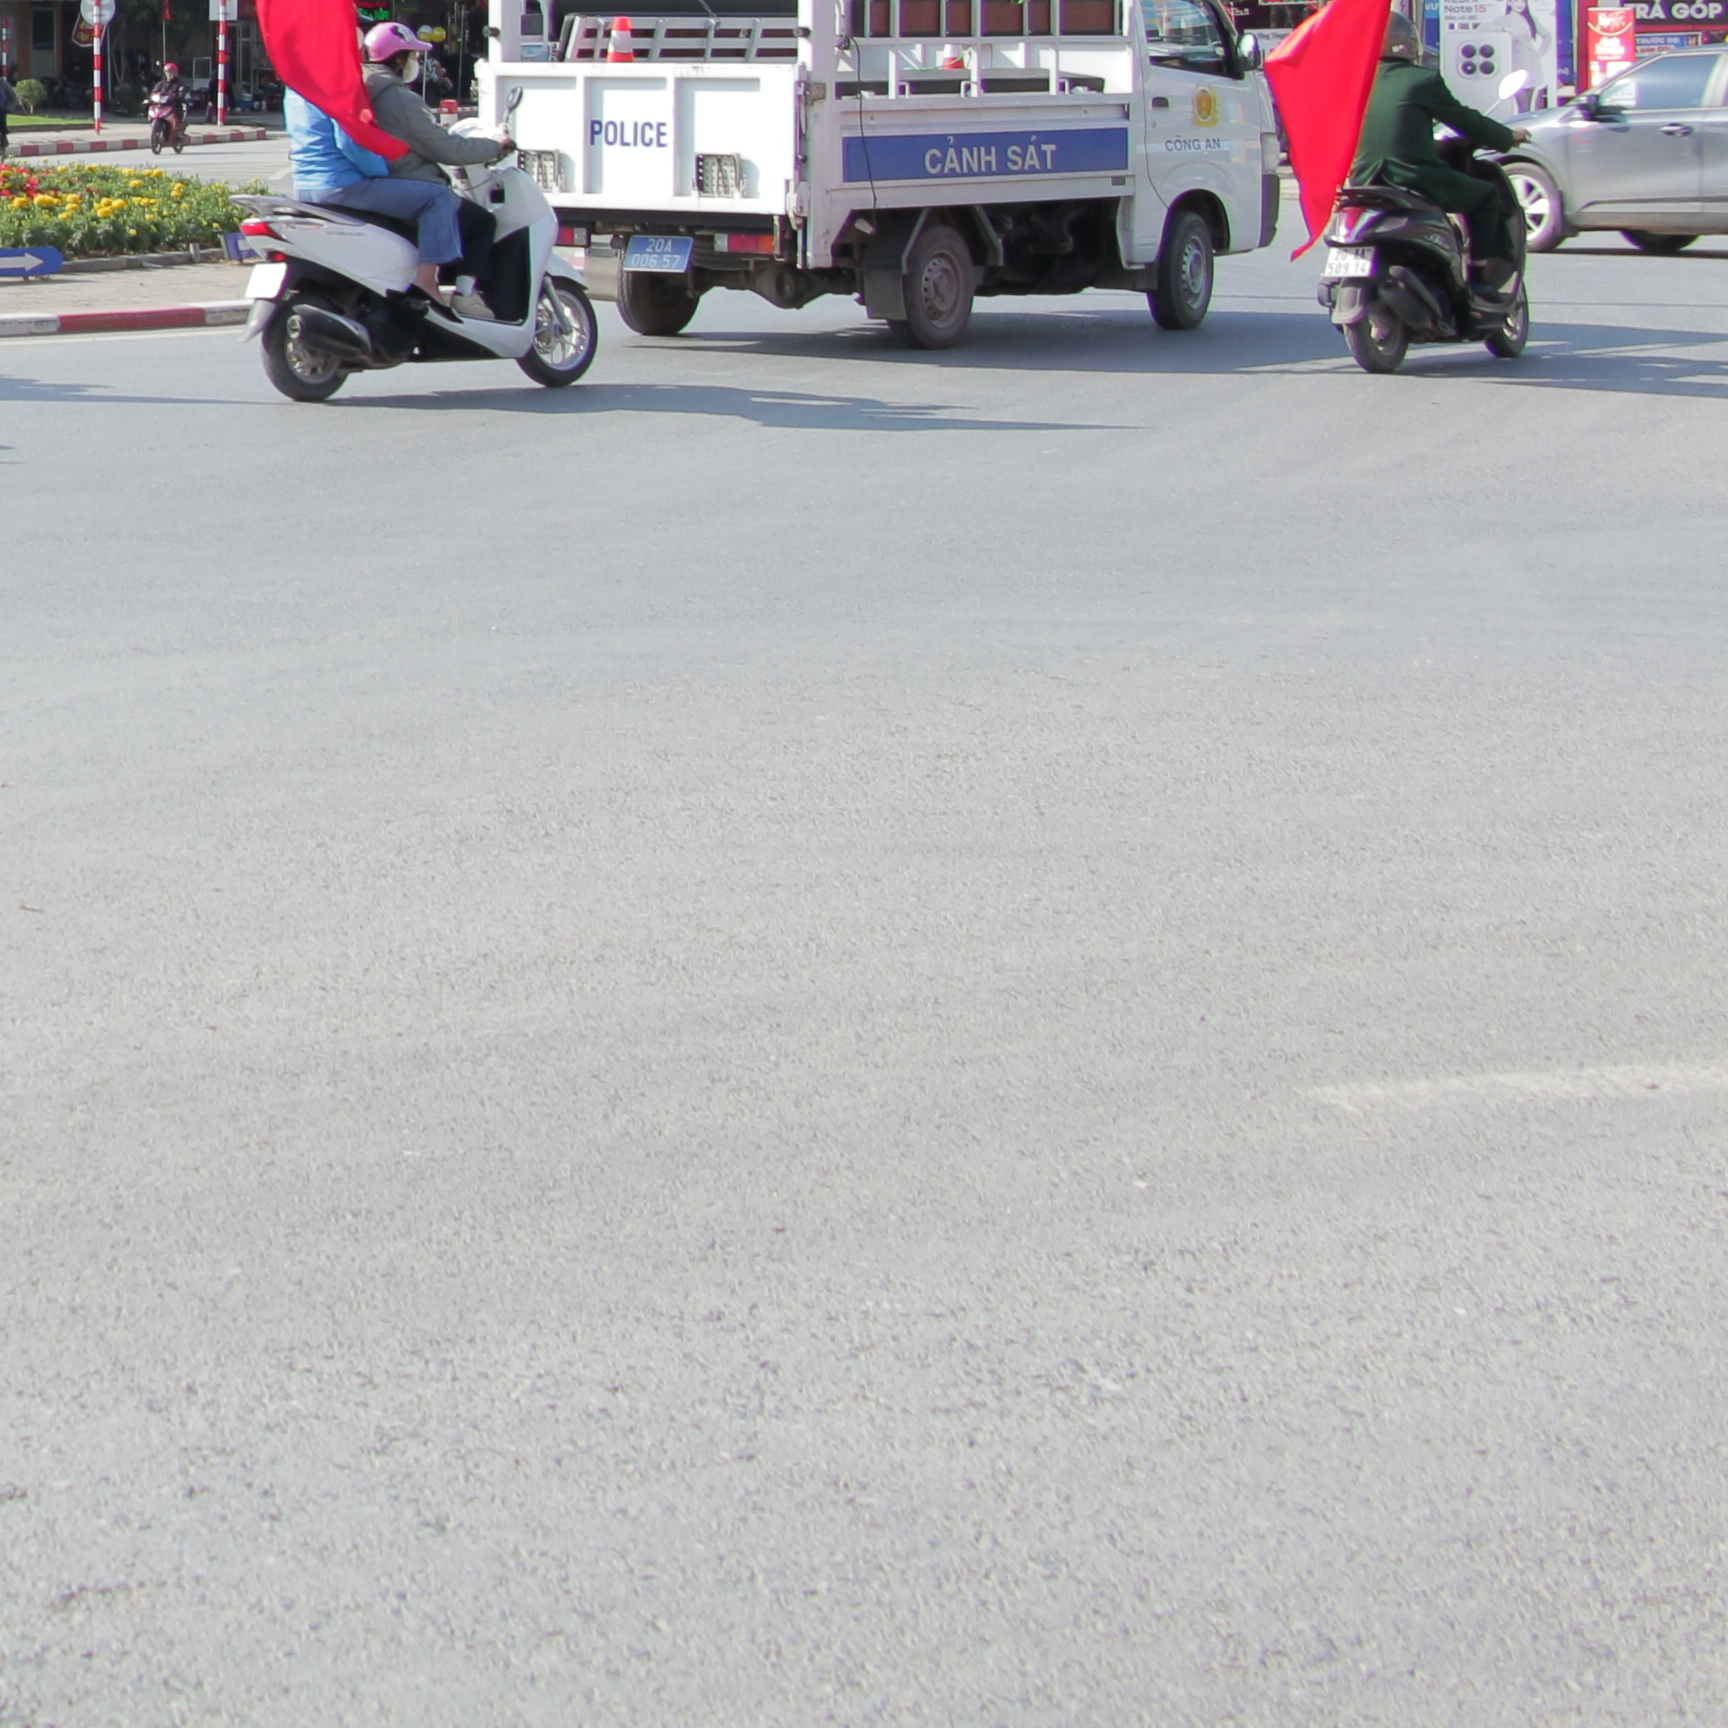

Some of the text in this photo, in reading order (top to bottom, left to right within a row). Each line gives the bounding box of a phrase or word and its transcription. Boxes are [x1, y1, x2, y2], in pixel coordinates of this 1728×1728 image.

[1444, 4, 1487, 13] Note 15
[1671, 0, 1723, 20] GÓP
[590, 119, 667, 147] POLICE
[1164, 135, 1222, 152] CÔNG AN
[924, 135, 1057, 174] CẢNH SÁT
[645, 237, 673, 253] 20A
[631, 253, 682, 269] 006.57
